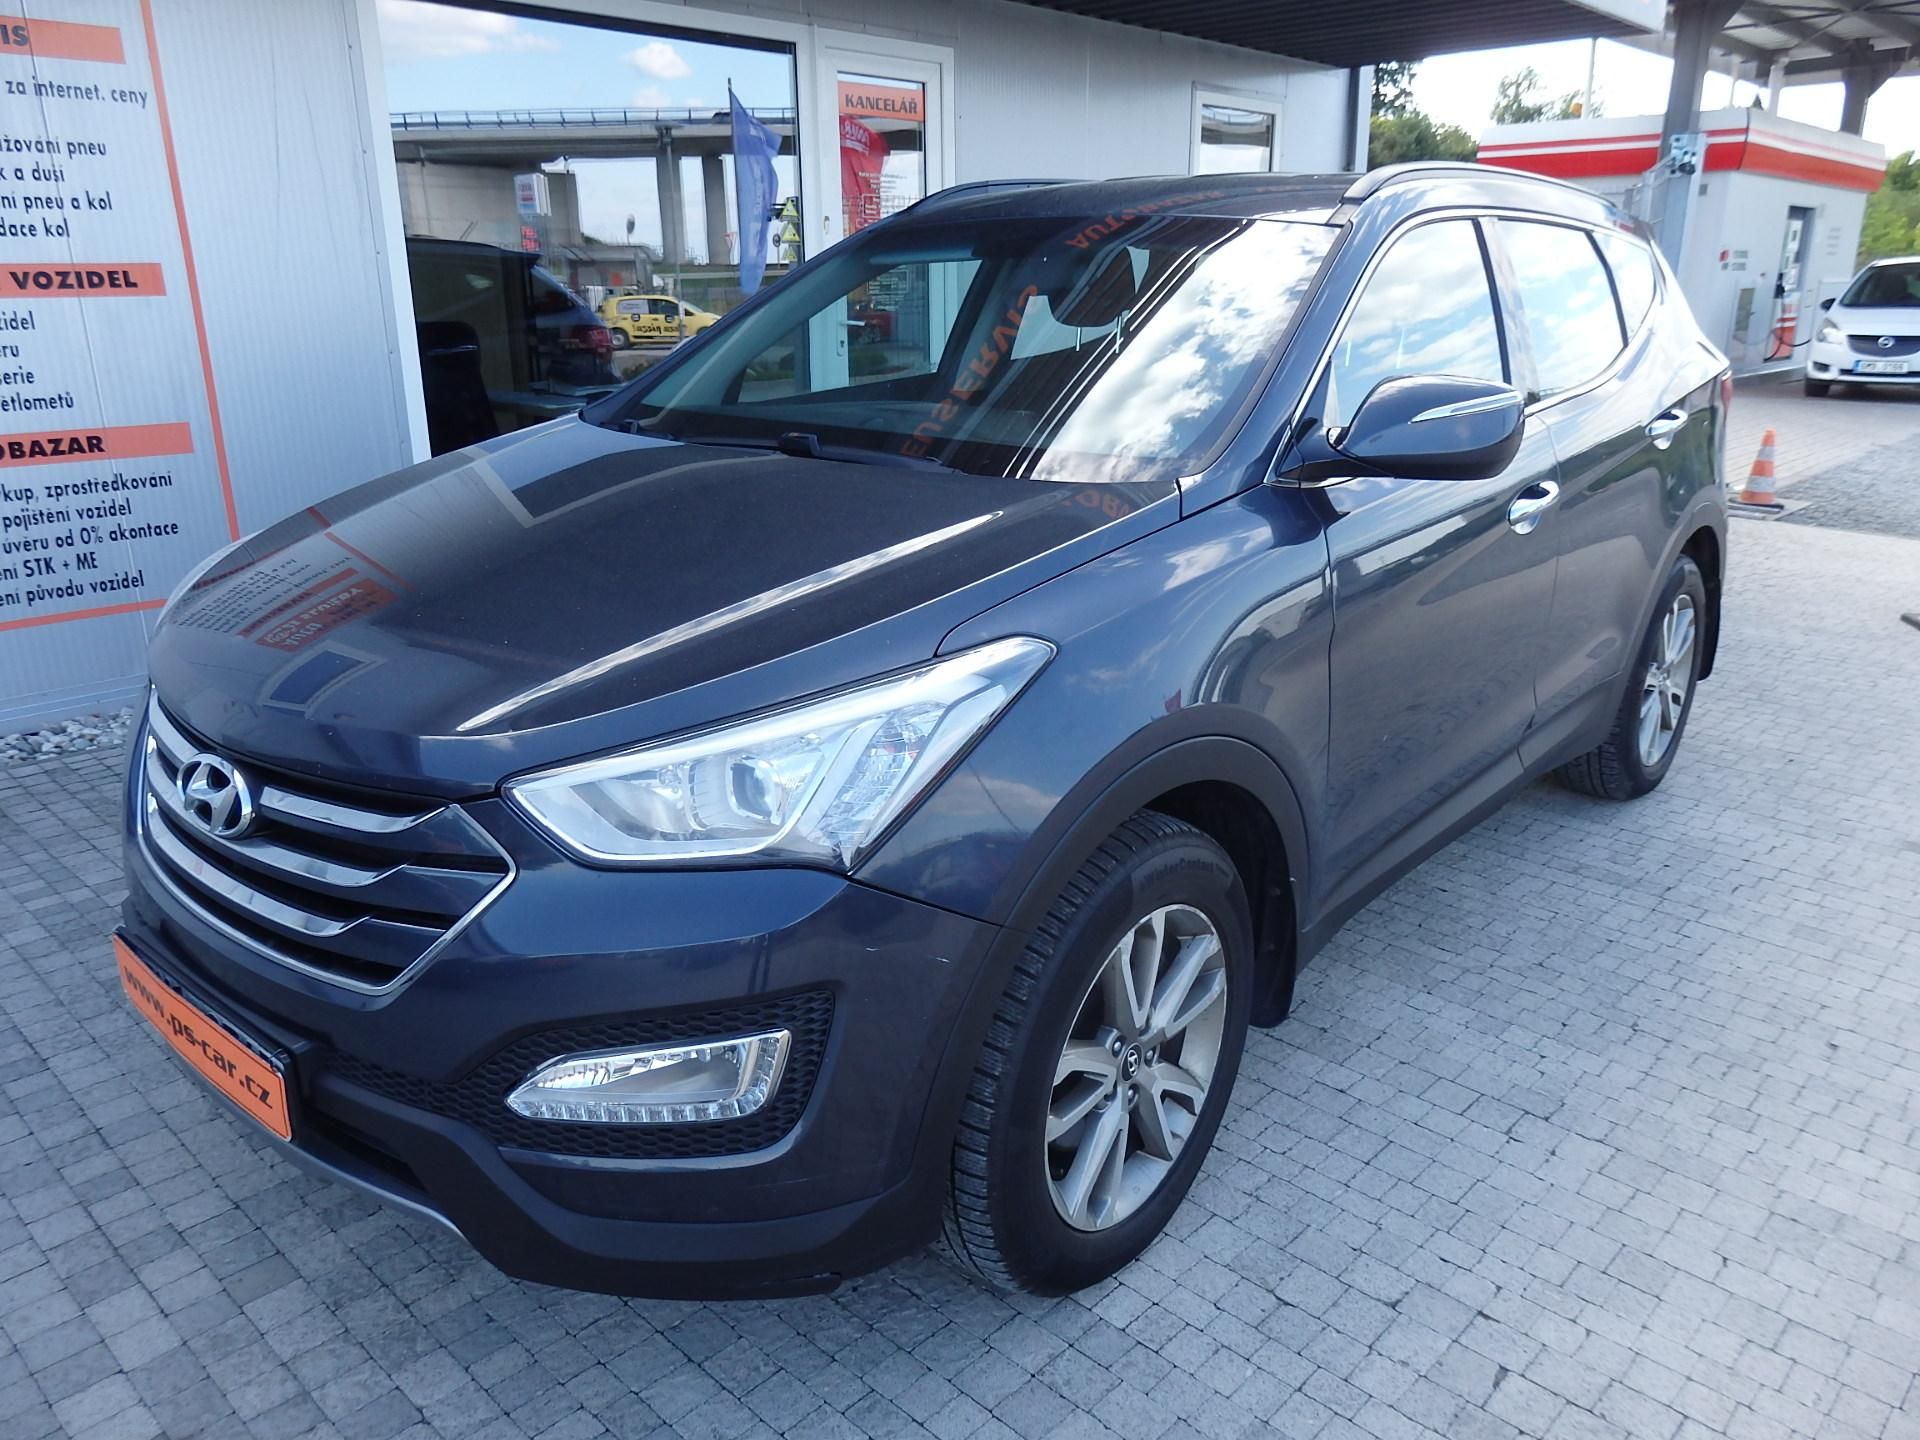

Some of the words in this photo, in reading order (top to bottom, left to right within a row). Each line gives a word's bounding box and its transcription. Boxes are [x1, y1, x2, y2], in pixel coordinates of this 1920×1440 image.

[5, 80, 26, 95] za
[32, 75, 106, 101] internet.
[111, 88, 148, 109] ceny
[845, 93, 918, 114] KANCELÁŘ
[0, 134, 61, 154] žování
[66, 140, 107, 159] pneu
[14, 167, 25, 181] a
[23, 196, 64, 214] pneu
[71, 197, 81, 210] a
[85, 190, 113, 210] kol
[42, 216, 70, 238] kol
[9, 270, 139, 290] VOZIDEL
[0, 345, 20, 358] ru
[0, 483, 39, 505] kup,
[44, 470, 173, 501] zprostředkování
[2, 505, 71, 533] pojištění
[75, 497, 132, 521] vozidel
[2, 536, 49, 554] úvěru
[55, 528, 75, 548] od
[79, 525, 104, 545] 0%
[109, 522, 179, 542] akontace
[23, 556, 56, 578] STK
[76, 551, 98, 571] ME
[26, 578, 84, 607] původu
[89, 569, 145, 593] vozidel
[124, 965, 273, 1110] www.ps-car.cz
